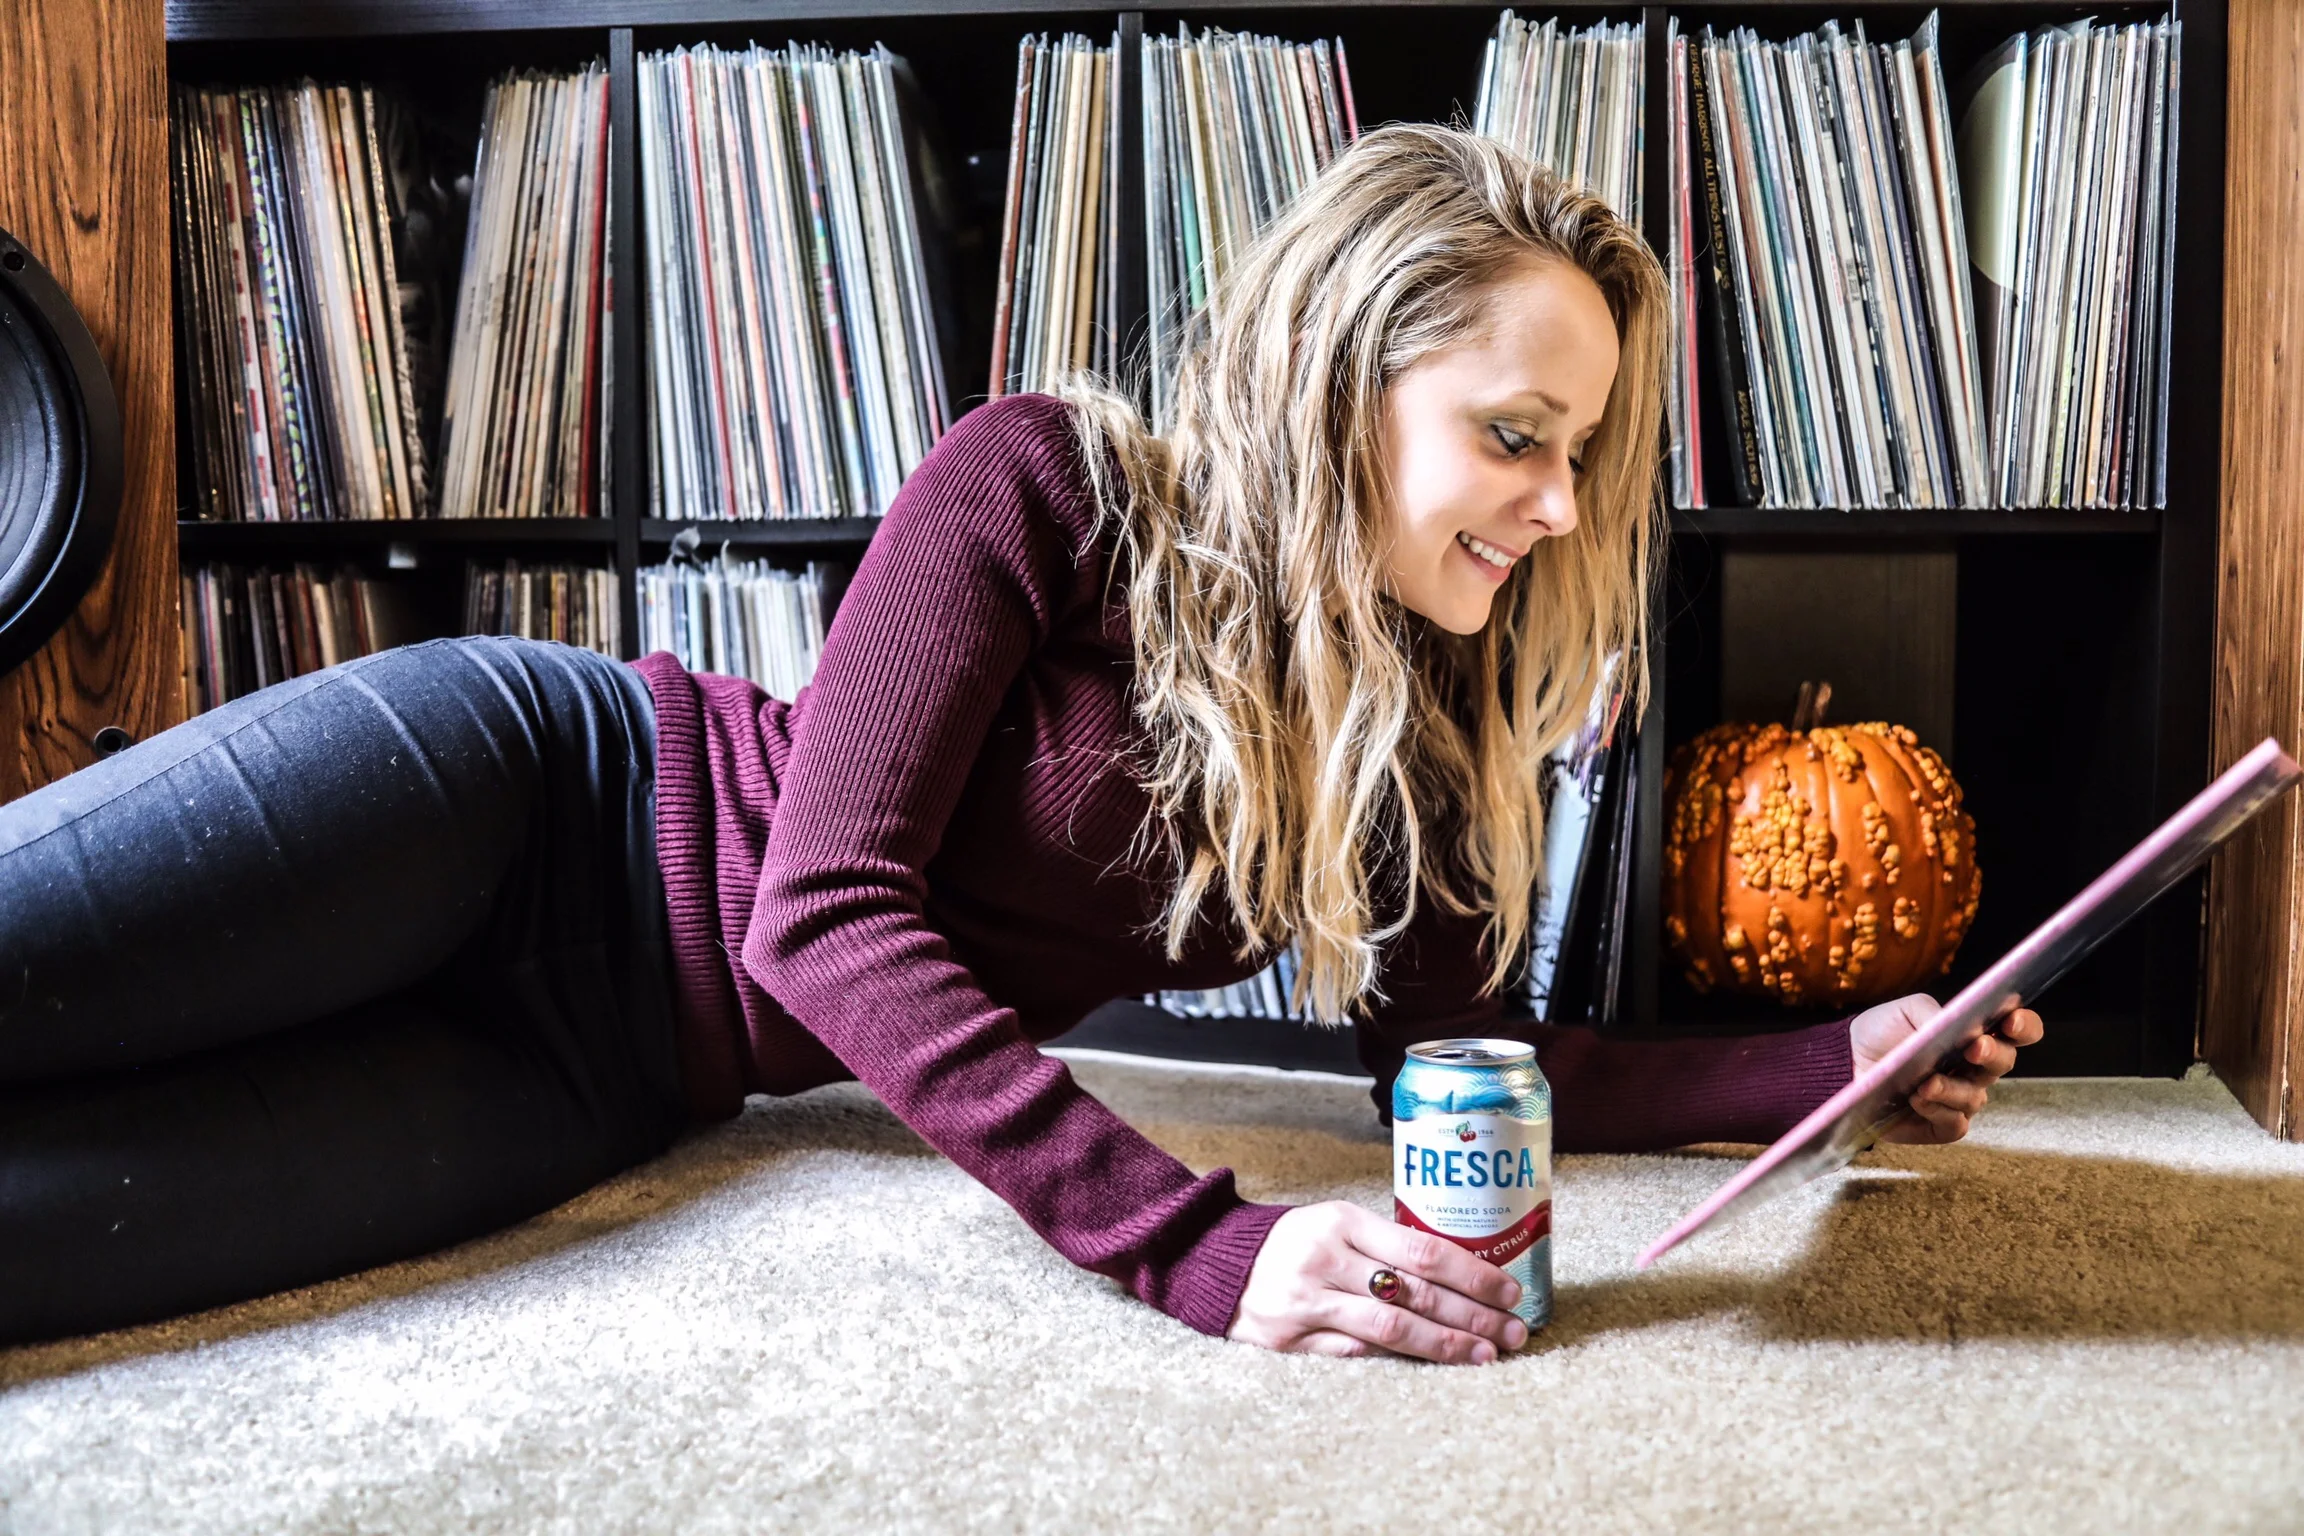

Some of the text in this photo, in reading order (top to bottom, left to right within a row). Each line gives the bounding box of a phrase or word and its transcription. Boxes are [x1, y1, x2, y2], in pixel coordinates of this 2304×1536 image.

[1689, 43, 1703, 90] GEORGE
[1695, 93, 1711, 152] HARRISON
[1704, 157, 1715, 179] ALL
[1707, 180, 1721, 222] THINGS
[1713, 224, 1726, 255] MUST
[1737, 389, 1750, 429] APPLE
[1404, 1143, 1534, 1188] FRESCA
[1425, 1204, 1512, 1215] FLAVORED SODA
[1493, 1228, 1529, 1255] CITRUS
